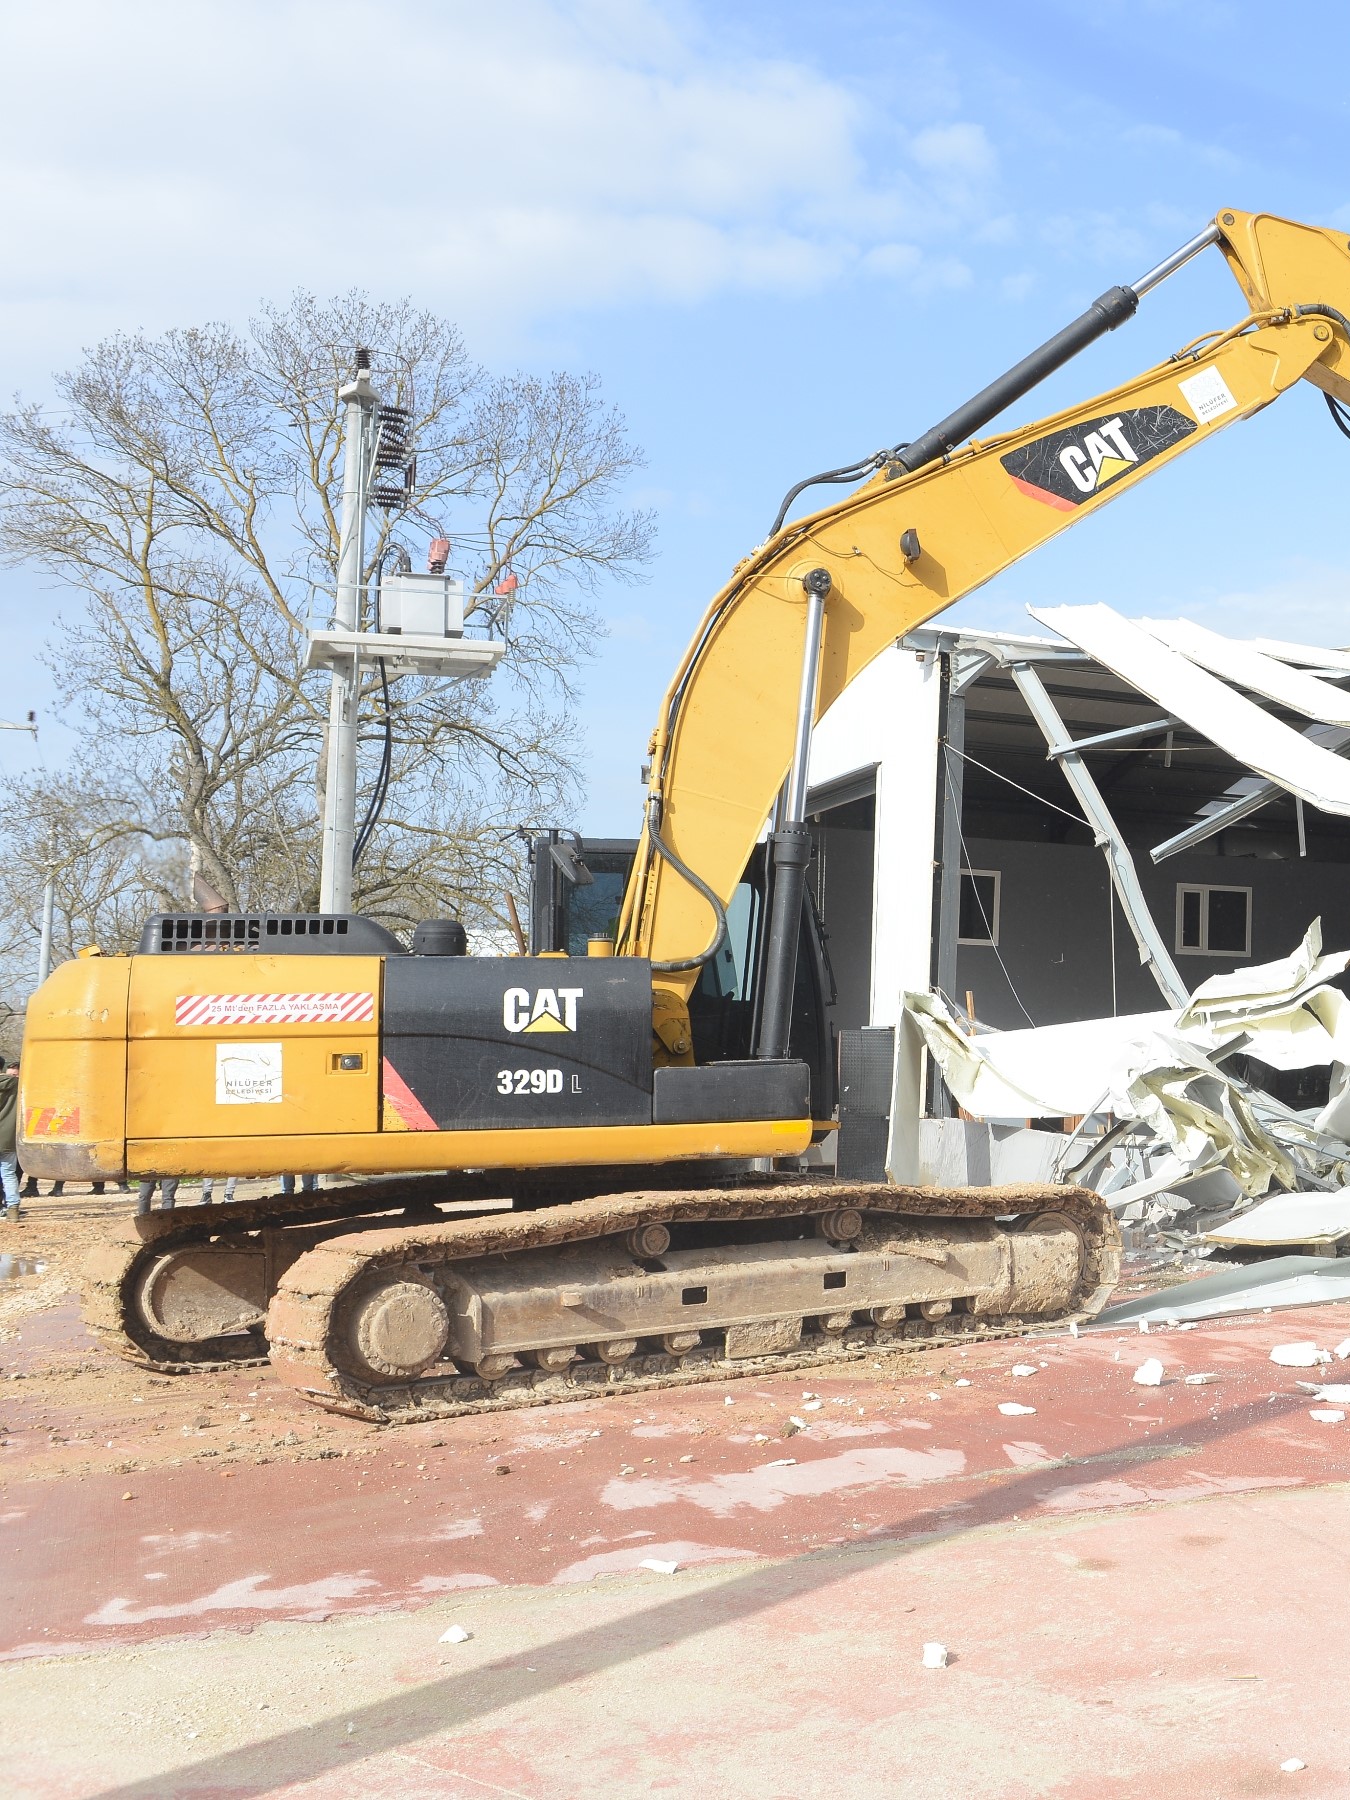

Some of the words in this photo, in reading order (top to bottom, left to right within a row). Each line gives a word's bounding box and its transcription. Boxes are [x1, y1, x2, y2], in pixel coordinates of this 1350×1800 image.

[1199, 393, 1226, 410] NİLÜFER
[1059, 417, 1139, 493] CAT
[288, 1003, 339, 1012] YAKLAŞMA
[503, 987, 583, 1032] CAT
[226, 1078, 273, 1087] NİLÜFER
[497, 1069, 563, 1094] 329D
[572, 1074, 582, 1094] L
